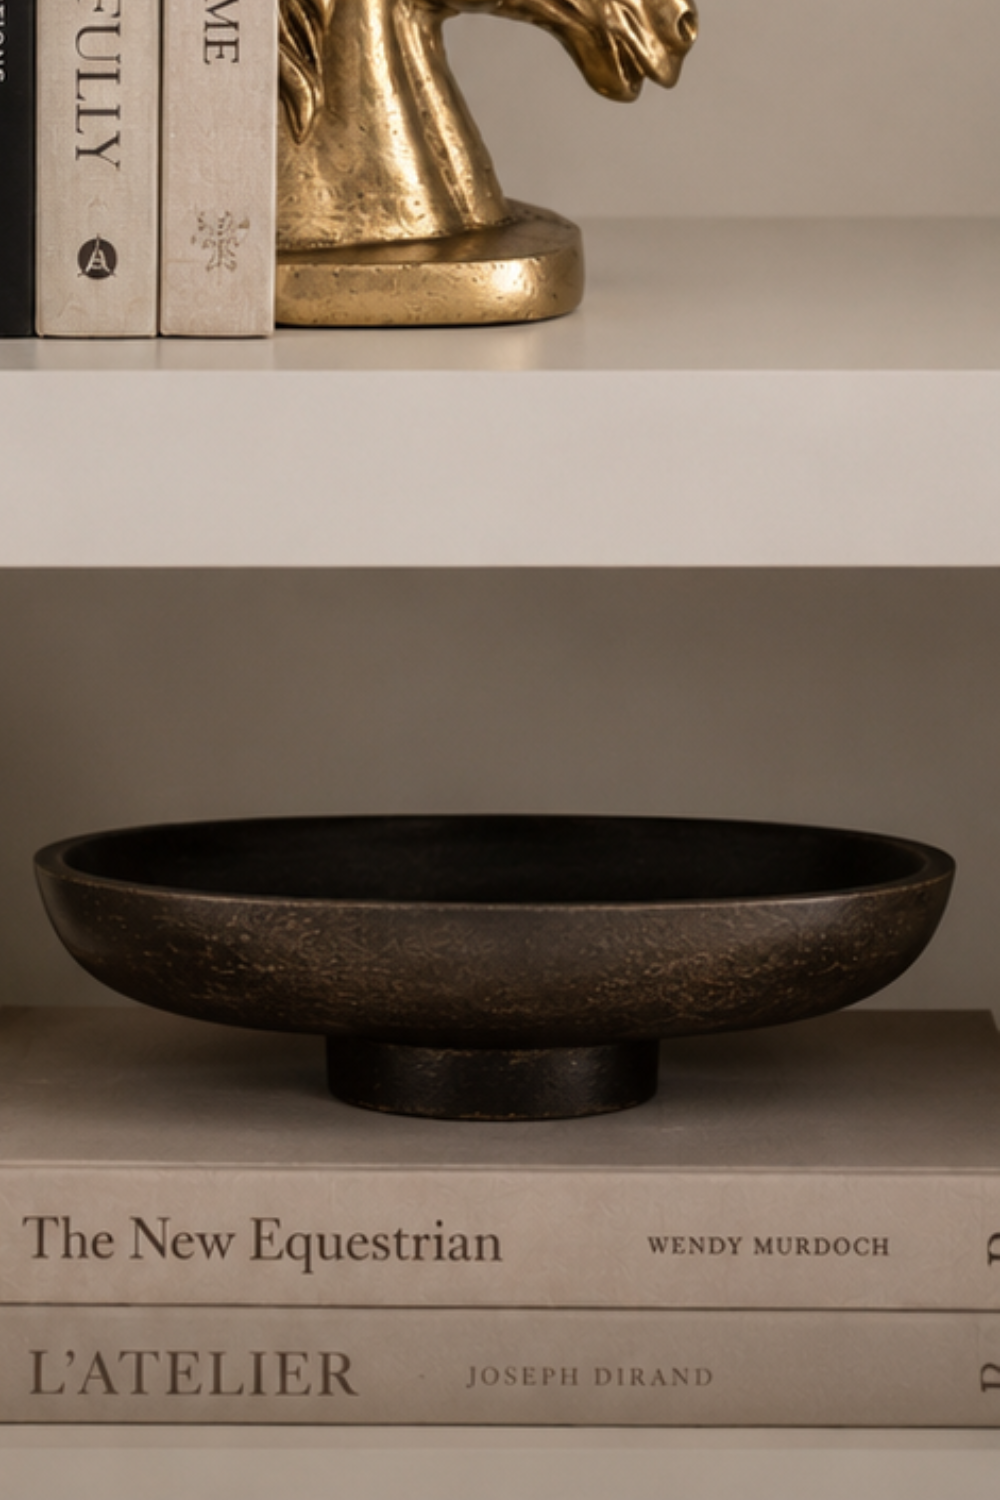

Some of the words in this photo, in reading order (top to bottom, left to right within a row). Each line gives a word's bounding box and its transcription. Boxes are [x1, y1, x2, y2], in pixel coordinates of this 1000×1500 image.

[22, 1215, 115, 1260] The
[130, 1216, 236, 1261] New
[250, 1217, 502, 1275] Equestrian
[647, 1236, 743, 1257] WENDY
[753, 1236, 890, 1258] MURDOCH
[466, 1365, 580, 1389] JOSEPH
[594, 1367, 714, 1388] DIRAND
